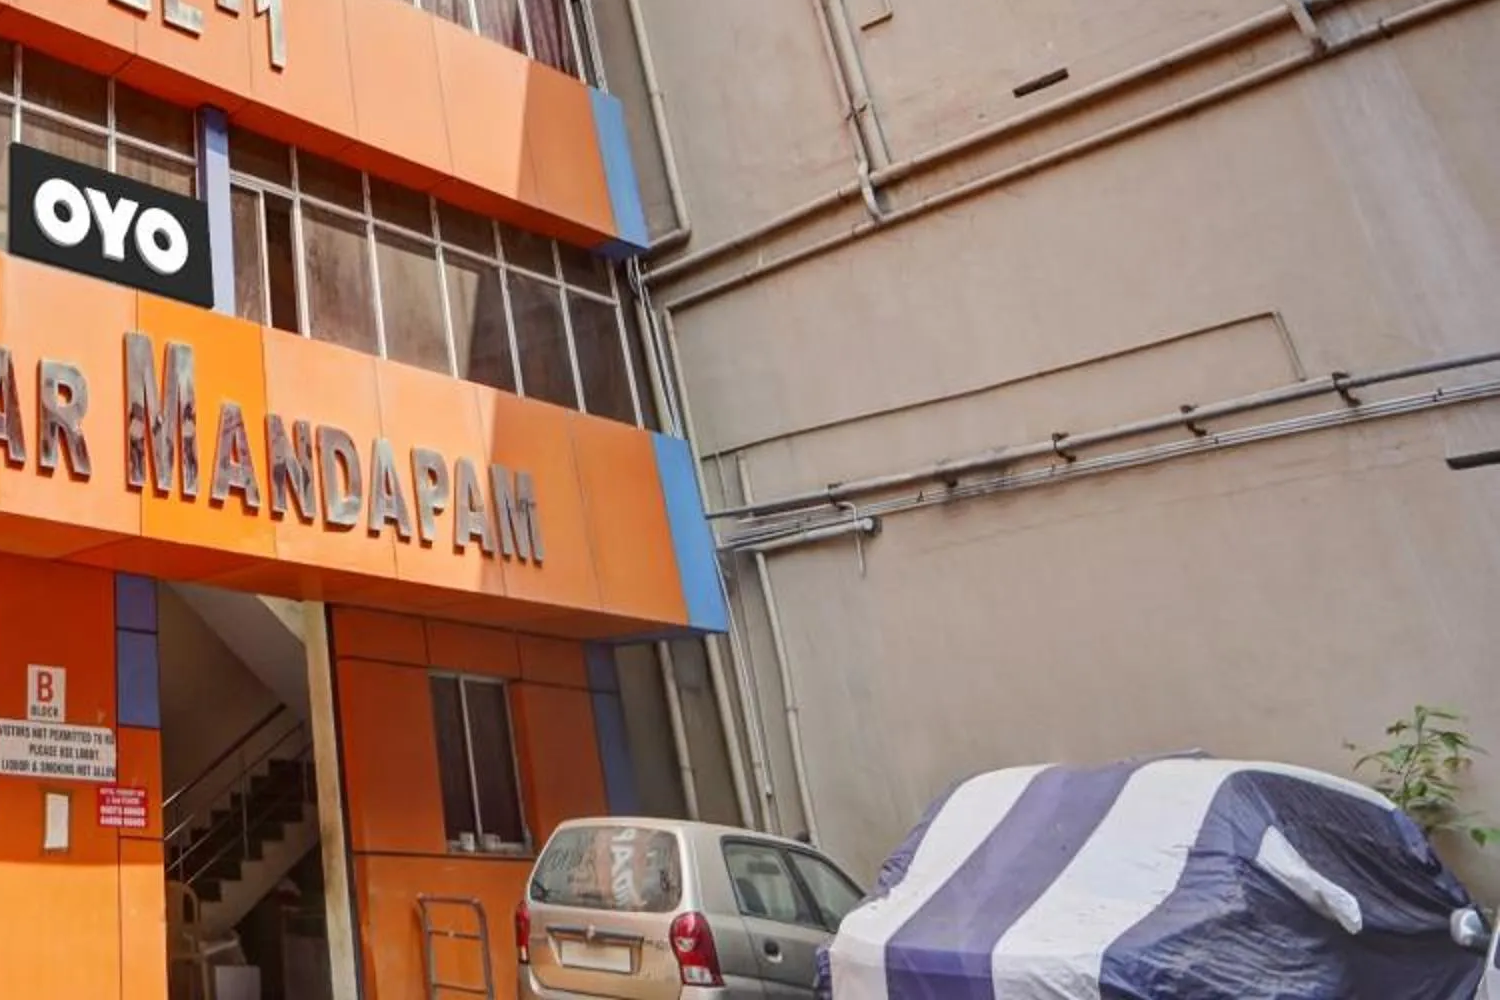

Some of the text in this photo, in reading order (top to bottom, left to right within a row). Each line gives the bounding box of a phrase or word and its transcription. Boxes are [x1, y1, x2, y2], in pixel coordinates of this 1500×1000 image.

[33, 178, 189, 275] OYO
[123, 331, 544, 562] MANDAPAM
[37, 671, 54, 702] B
[30, 704, 59, 718] BLOCK
[32, 727, 47, 740] NOT
